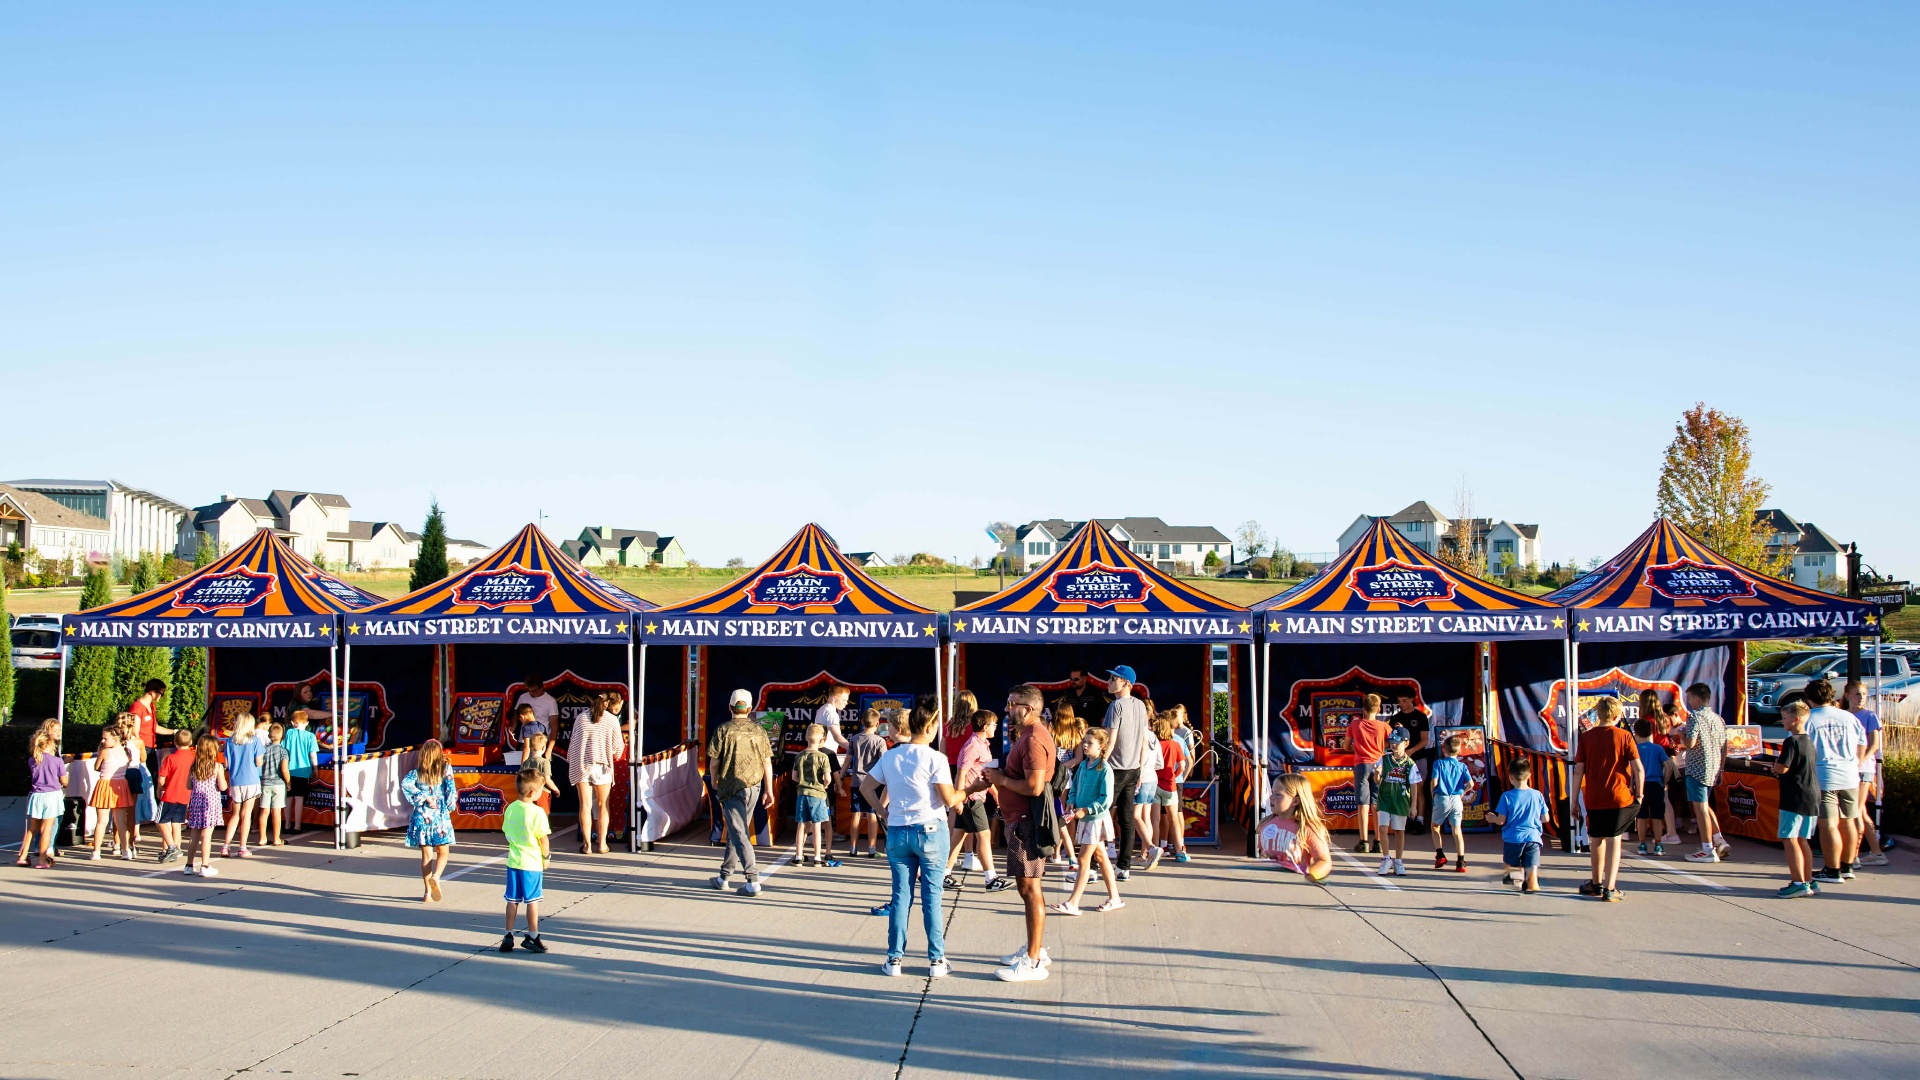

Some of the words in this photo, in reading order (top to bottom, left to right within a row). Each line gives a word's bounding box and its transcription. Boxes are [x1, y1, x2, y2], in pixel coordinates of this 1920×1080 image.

[1075, 576, 1121, 584] MAIN
[1376, 573, 1423, 581] MAIN
[1671, 572, 1719, 580] MAIN
[484, 577, 530, 585] MAIN
[777, 578, 822, 587] MAIN
[1369, 581, 1434, 589] STREET
[1667, 579, 1732, 587] STREET
[1066, 583, 1131, 591] STREET
[194, 588, 255, 596] STREET
[971, 617, 1031, 634] MAIN
[1036, 618, 1119, 634] STREET
[1124, 618, 1233, 634] CARNIVAL
[1286, 617, 1345, 634] MAIN
[1351, 617, 1434, 634] STREET
[1438, 616, 1547, 632] CARNIVAL
[1595, 616, 1654, 632] MAIN
[1660, 613, 1743, 631] STREET
[1748, 611, 1859, 628] CARNIVAL
[80, 622, 133, 638] MAIN
[138, 622, 212, 638] STREET
[216, 623, 315, 638] CARNIVAL
[365, 621, 421, 636] MAIN
[425, 619, 503, 635] STREET
[507, 619, 611, 635] CARNIVAL
[662, 620, 720, 636] MAIN
[725, 620, 806, 637] STREET
[810, 621, 918, 638] CARNIVAL
[223, 700, 252, 710] RING
[460, 704, 479, 716] TIC
[480, 700, 501, 710] TAC
[1320, 699, 1355, 708] DOWN
[471, 709, 492, 719] TOE
